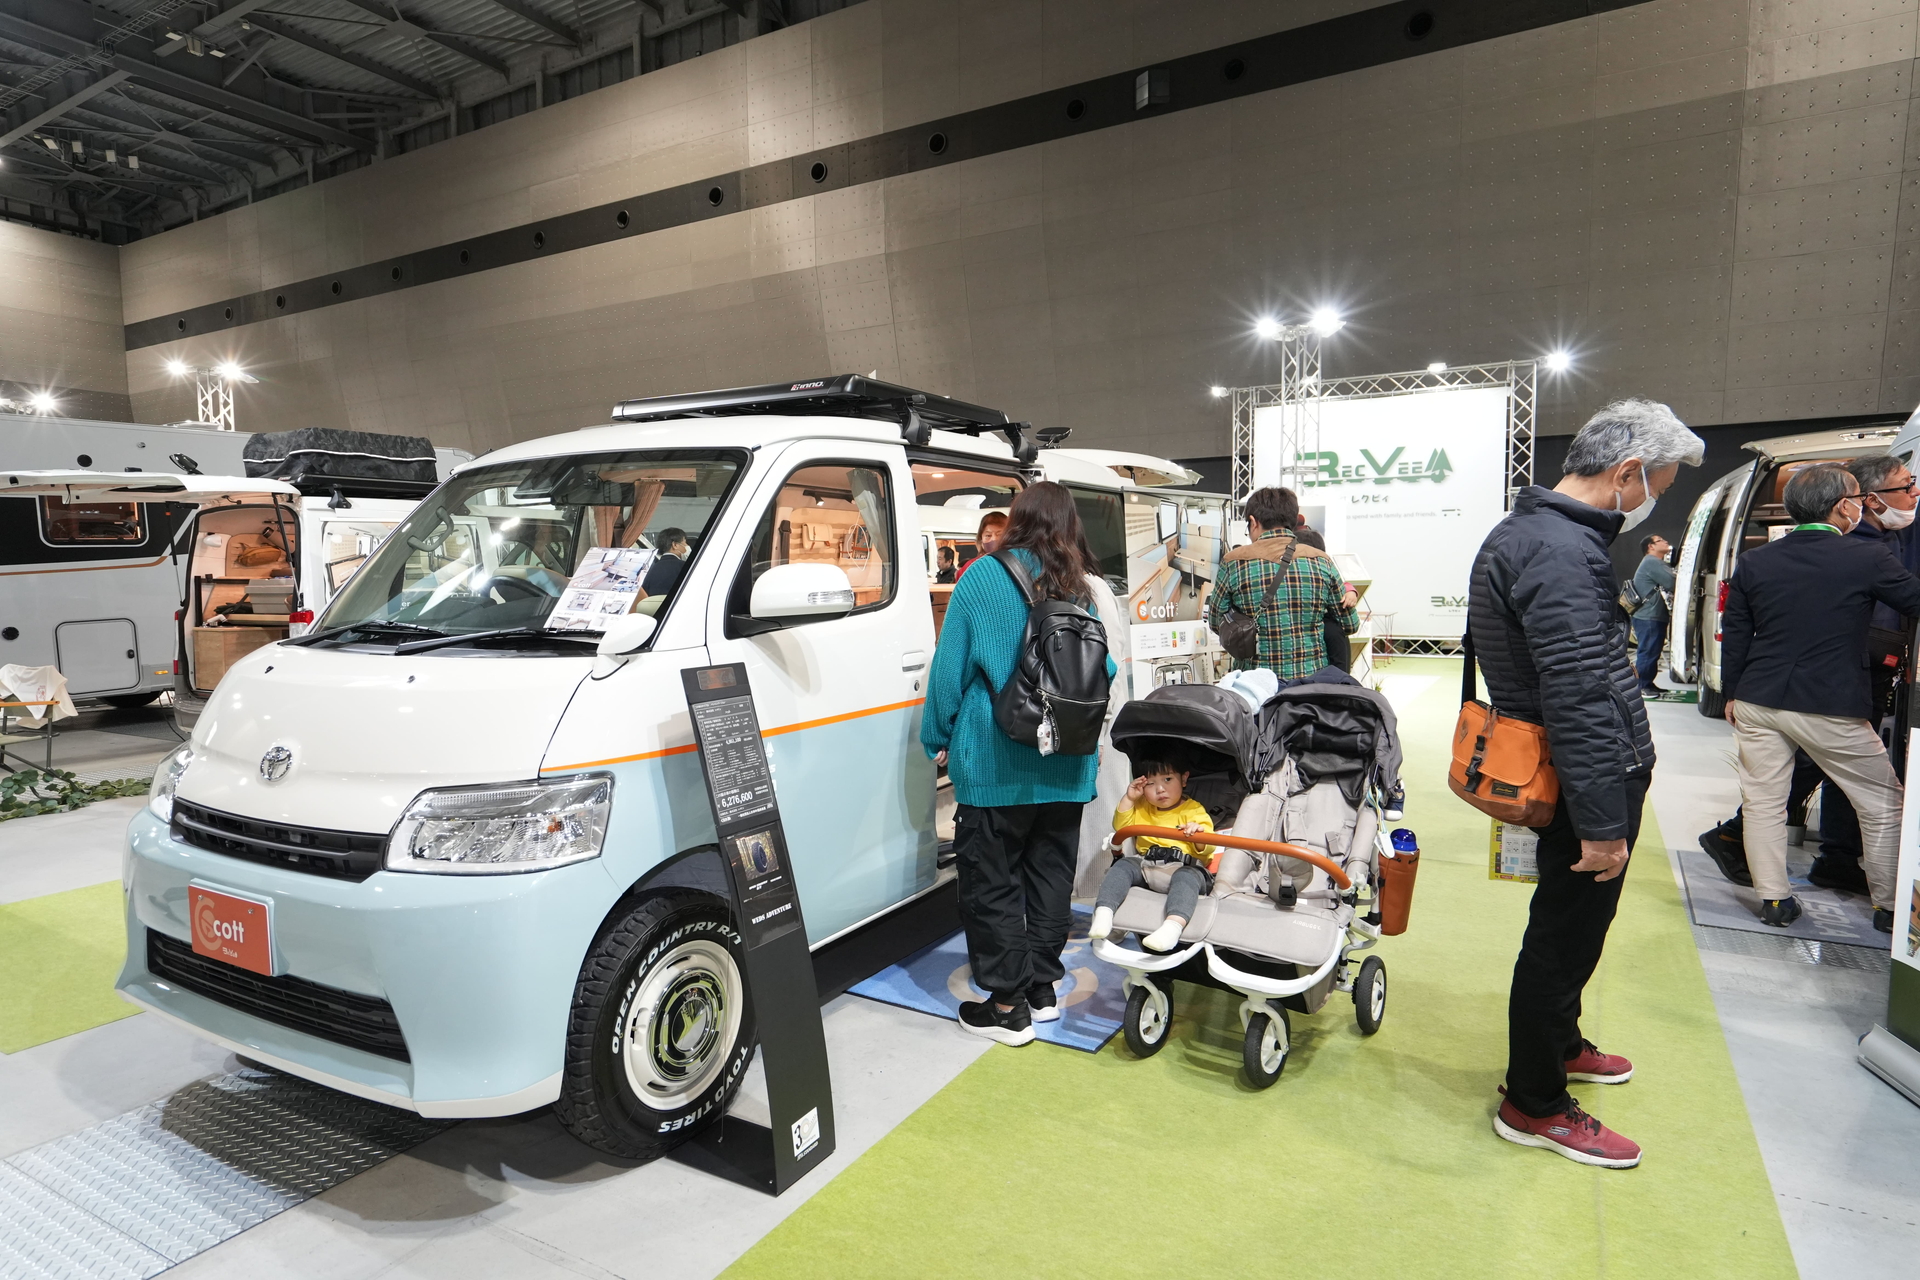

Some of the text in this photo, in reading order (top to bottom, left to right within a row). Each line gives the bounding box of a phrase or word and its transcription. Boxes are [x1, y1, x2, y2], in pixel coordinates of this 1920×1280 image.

[1150, 601, 1175, 619] cott
[751, 902, 793, 925] WEDS ADVENTURE
[213, 919, 245, 944] cott
[612, 979, 637, 1055] OPEN
[638, 921, 718, 978] COUNTRY
[657, 1045, 749, 1133] TOYO TIRES
